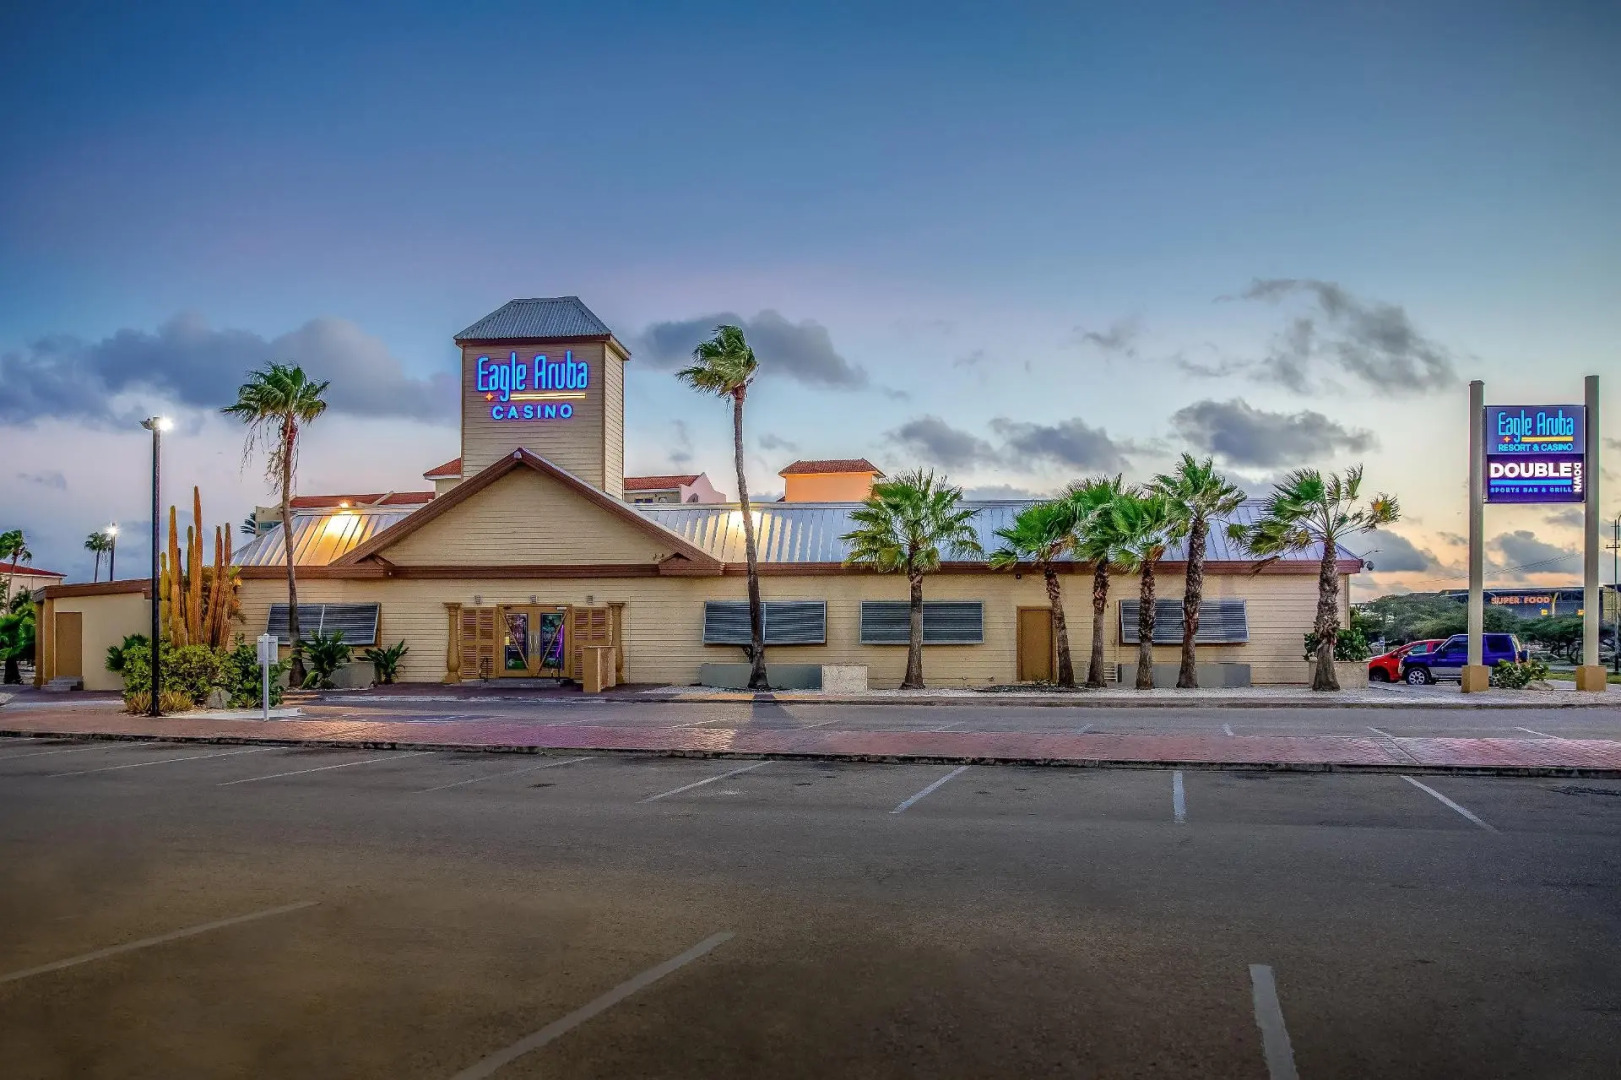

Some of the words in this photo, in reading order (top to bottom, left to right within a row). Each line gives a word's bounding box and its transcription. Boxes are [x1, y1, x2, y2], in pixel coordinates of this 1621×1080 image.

[477, 351, 527, 402] Eagle
[534, 350, 588, 389] Aruba
[492, 404, 573, 419] CASINO
[1498, 409, 1532, 443] Eagle
[1537, 409, 1574, 435] Aruba
[1498, 443, 1531, 452] RESORT
[1532, 443, 1540, 452] &
[1541, 443, 1574, 452] CASINO
[1490, 462, 1572, 478] DOUBLE
[1573, 462, 1582, 493] DOWN
[1491, 596, 1520, 605] SUPER
[1523, 596, 1550, 604] FOOD
